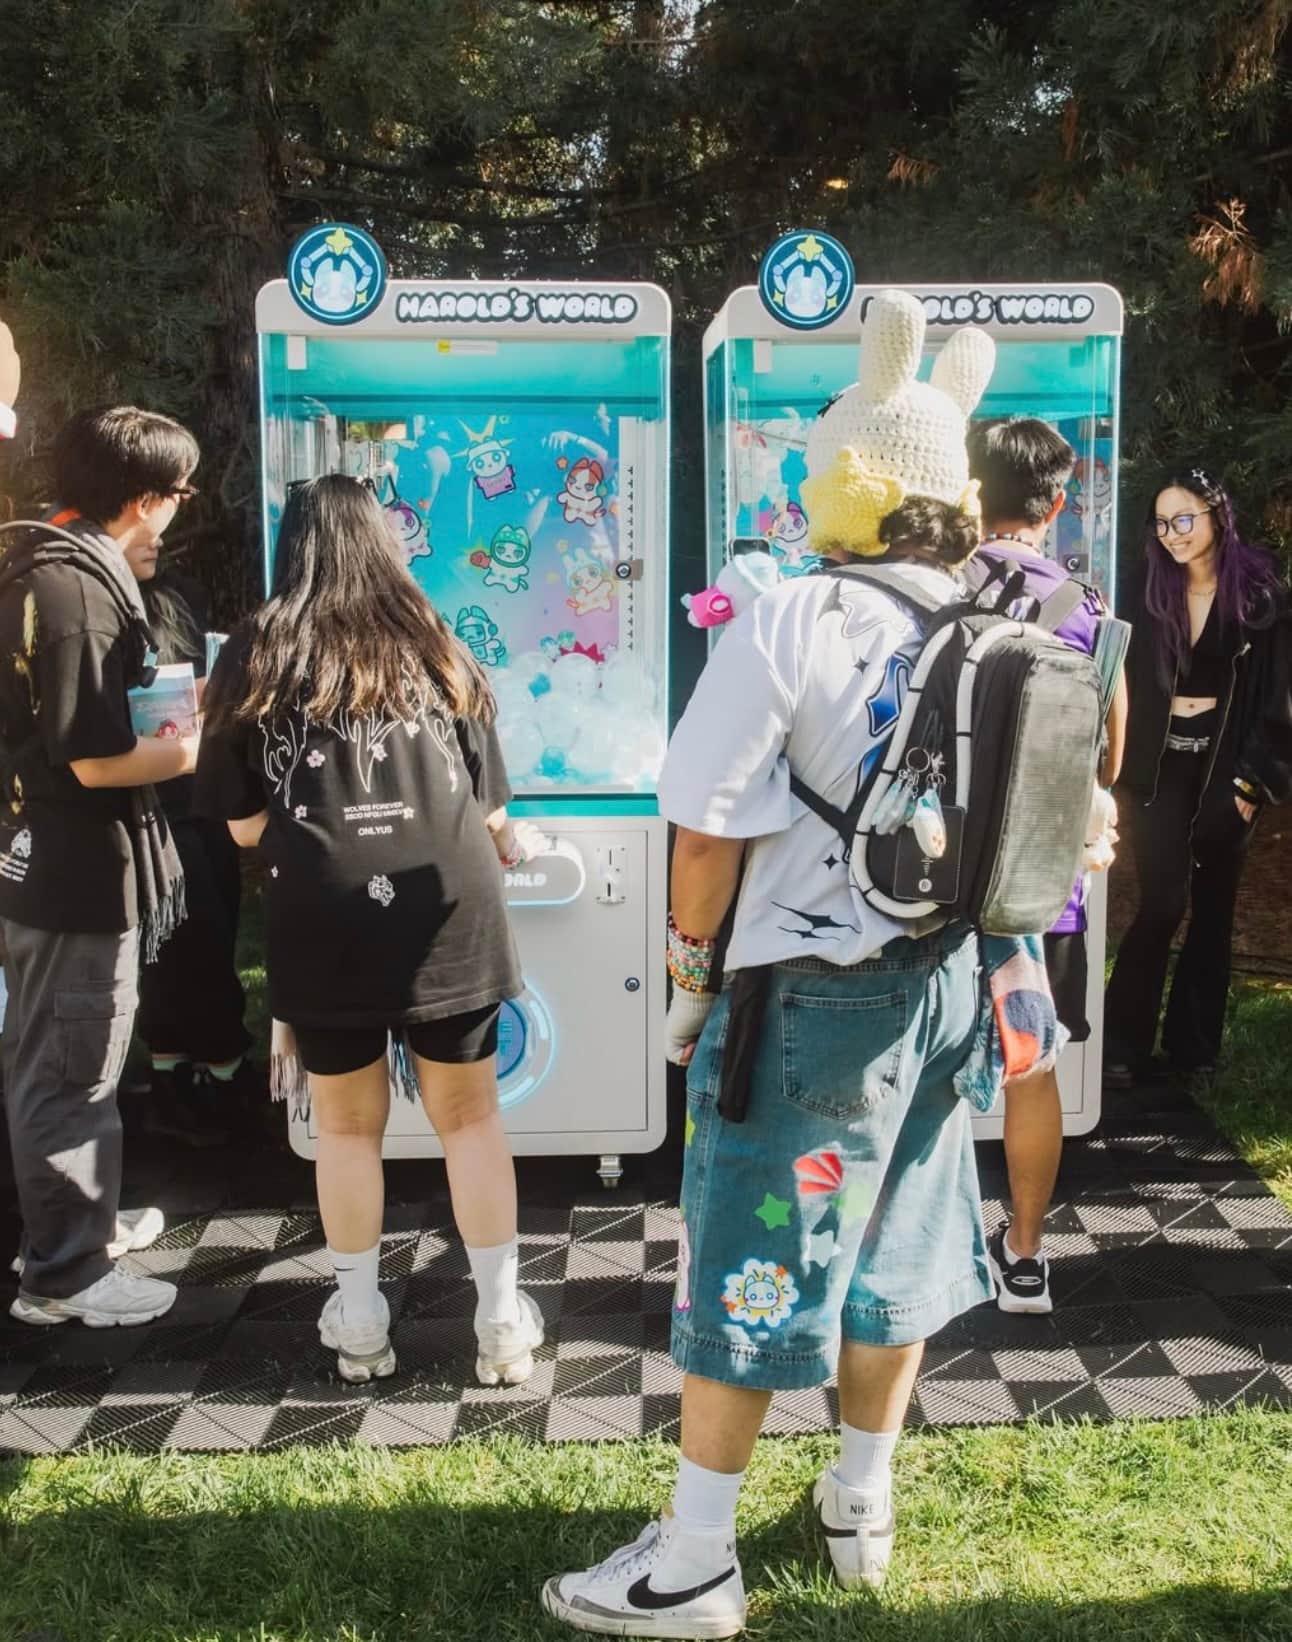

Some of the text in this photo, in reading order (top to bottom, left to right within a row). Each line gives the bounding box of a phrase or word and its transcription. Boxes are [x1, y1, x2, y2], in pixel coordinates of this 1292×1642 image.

[396, 287, 638, 323] HAROLD'S WORLD
[861, 290, 1094, 325] OLD'S WORLD
